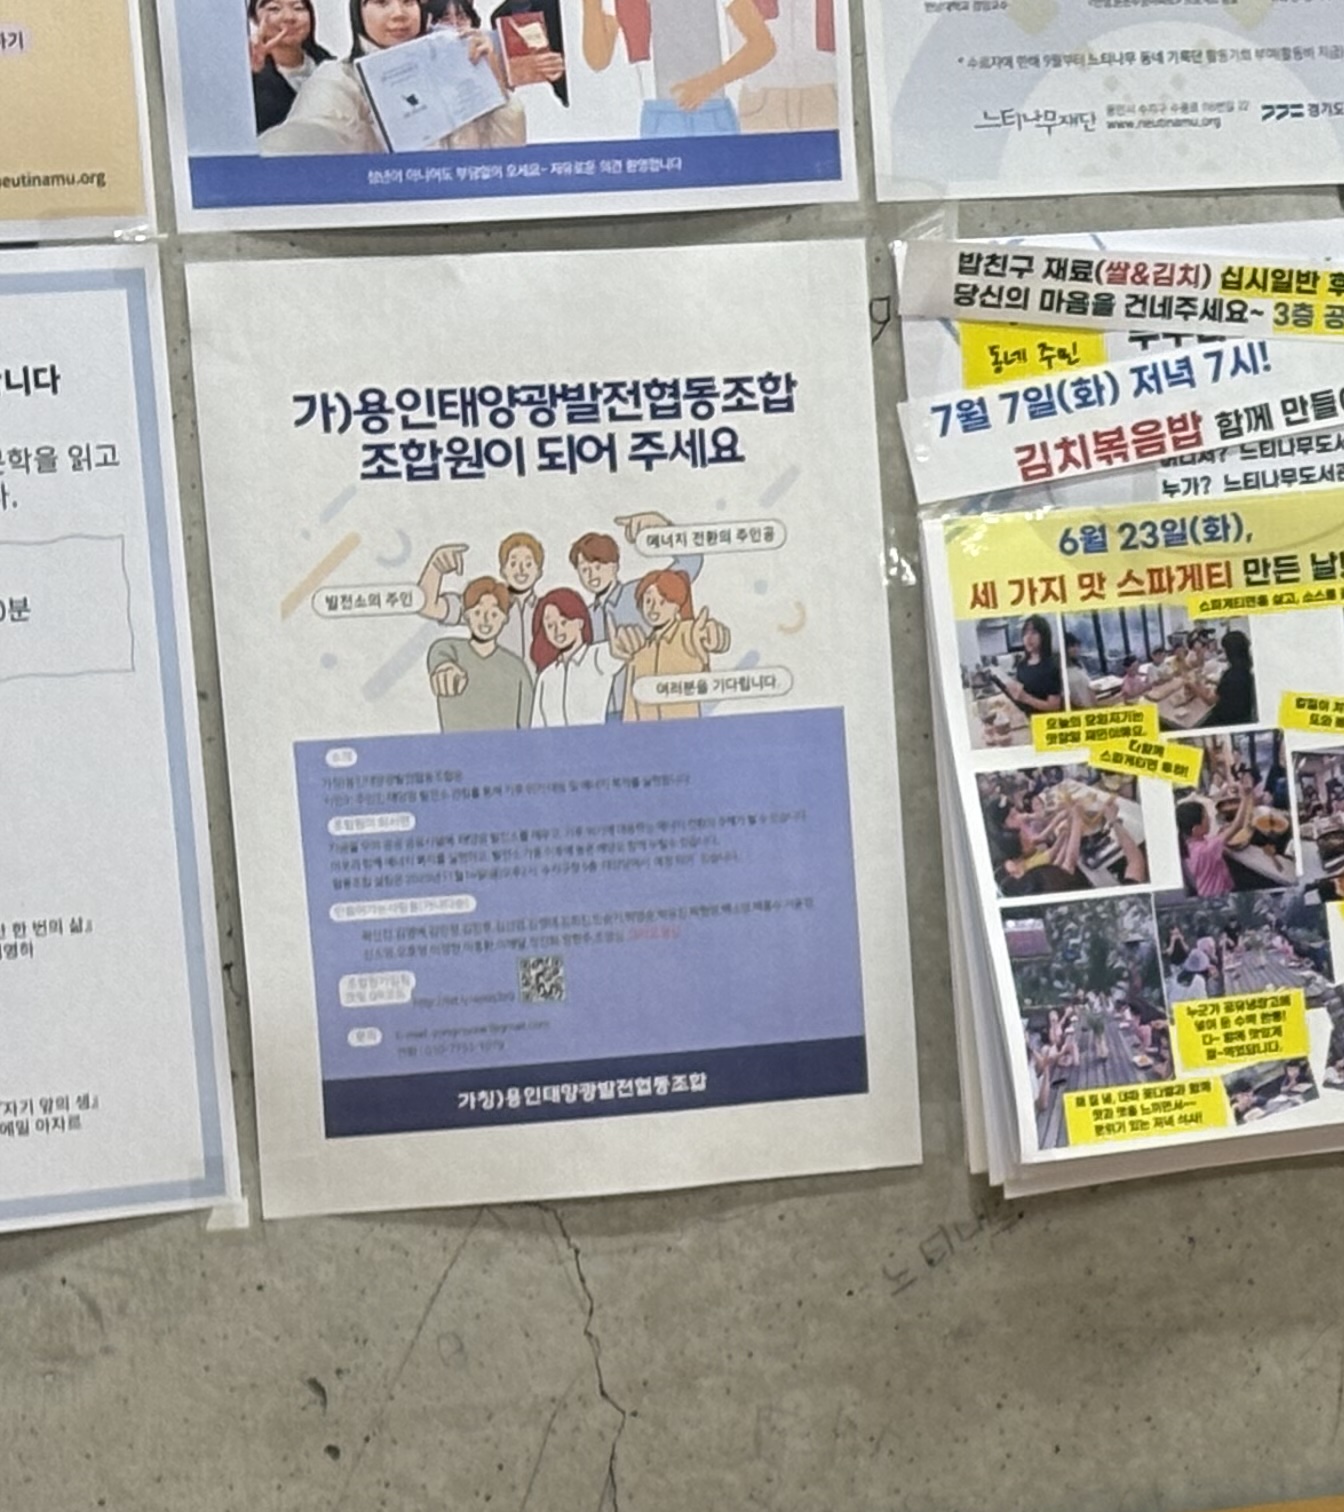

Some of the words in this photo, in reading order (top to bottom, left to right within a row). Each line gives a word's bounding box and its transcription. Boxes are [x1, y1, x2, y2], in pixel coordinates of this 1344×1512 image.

[974, 108, 1097, 135] 느티나무재단
[1308, 102, 1344, 117] 경기도
[957, 251, 1036, 279] 밥친구
[1041, 257, 1213, 290] 재료(쌀&김치)
[1219, 265, 1321, 295] 십시일반
[953, 282, 1031, 311] 당신의
[1038, 289, 1117, 318] 마음을
[1124, 293, 1265, 326] 건네주세요~
[1272, 301, 1316, 329] 3층
[0, 364, 61, 396] 니다
[987, 344, 1028, 374] 동네
[929, 396, 993, 438] 7월
[998, 369, 1121, 426] 7일(화)
[1129, 355, 1198, 399] 저녁
[1202, 341, 1273, 384] 7시!
[67, 443, 121, 471] 읽고
[359, 430, 527, 483] 조합원이
[537, 433, 618, 476] 되어
[627, 426, 746, 472] 주세요
[1013, 409, 1205, 483] 김치볶음밥
[1214, 404, 1276, 441] 함께
[1161, 474, 1214, 499] 누가?
[1057, 523, 1110, 558] 6월
[1116, 511, 1254, 552] 23일(화),
[969, 579, 1000, 611] 세
[1007, 574, 1068, 608] 가지
[1076, 570, 1108, 603] 맛
[1115, 559, 1234, 599] 스파게티
[1242, 552, 1302, 588] 만든
